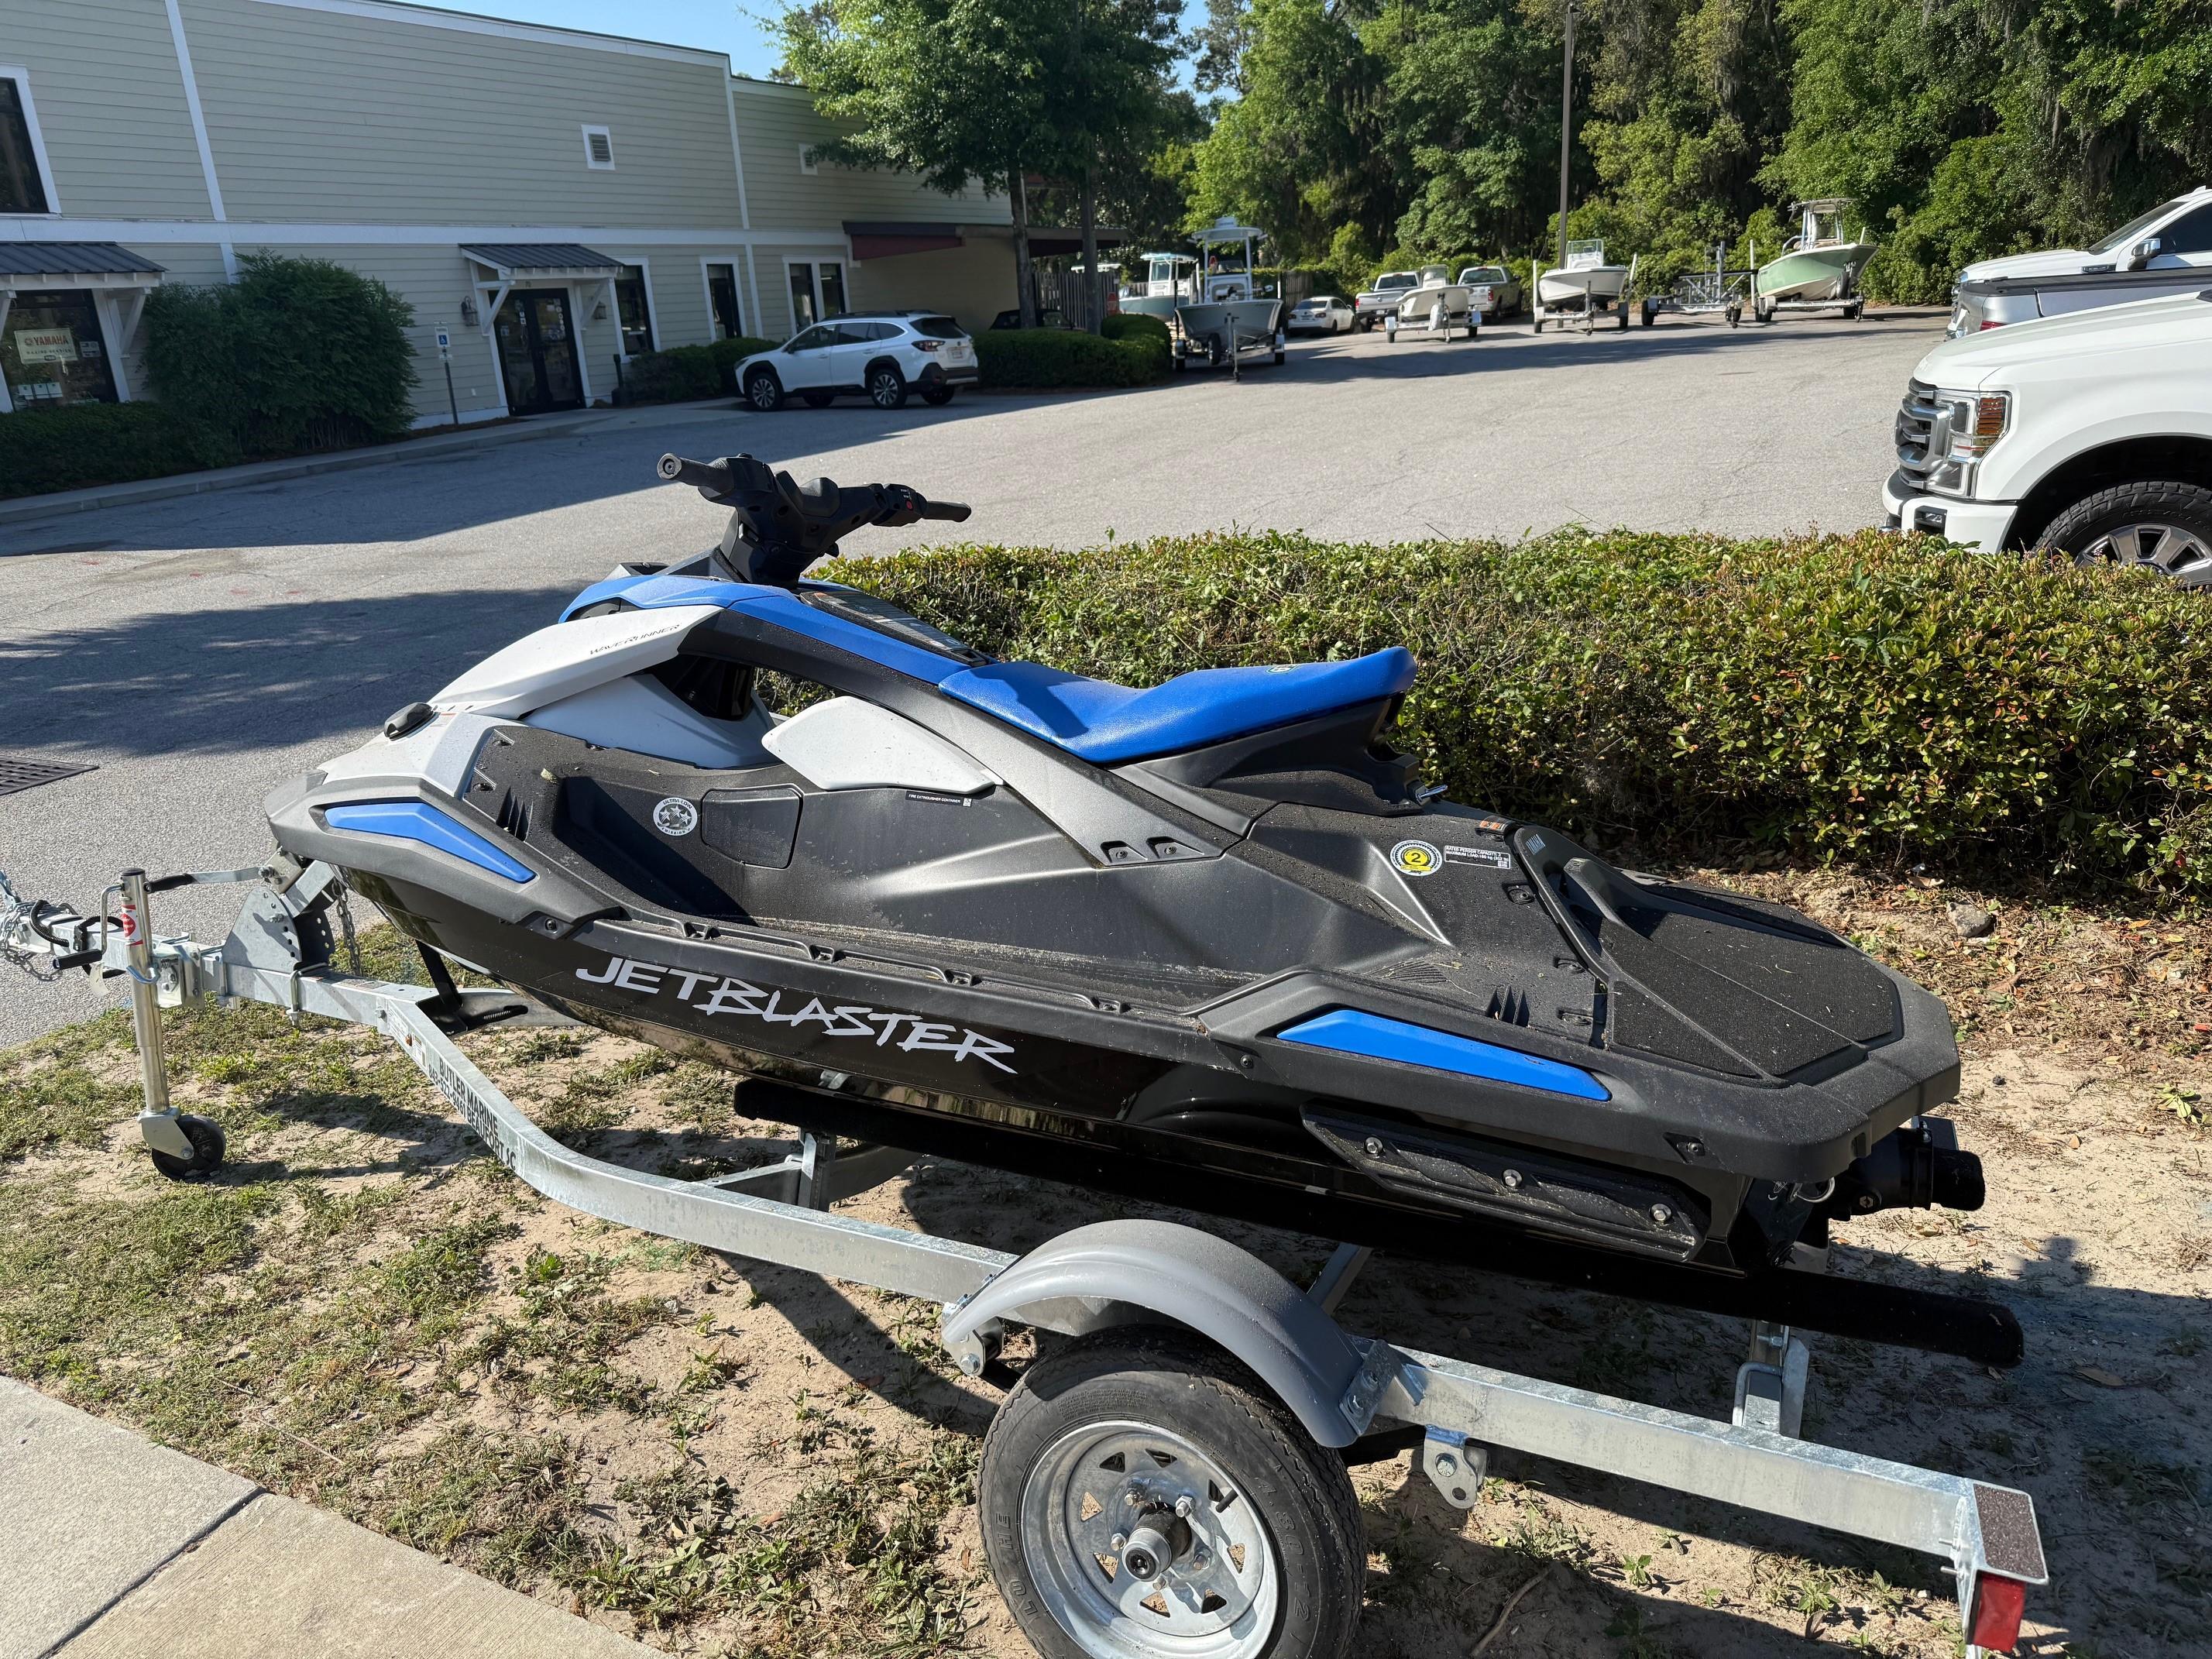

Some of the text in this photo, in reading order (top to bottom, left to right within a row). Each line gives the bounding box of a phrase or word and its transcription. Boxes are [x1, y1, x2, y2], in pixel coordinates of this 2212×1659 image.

[33, 335, 69, 346] YAMAHA
[589, 623, 682, 655] WAVERUNNER
[681, 800, 693, 809] LOW
[1410, 852, 1421, 863] 2
[439, 1056, 499, 1137] BUTLER MARINE
[466, 1105, 504, 1158] BEAUFORT
[505, 1147, 517, 1170] SC
